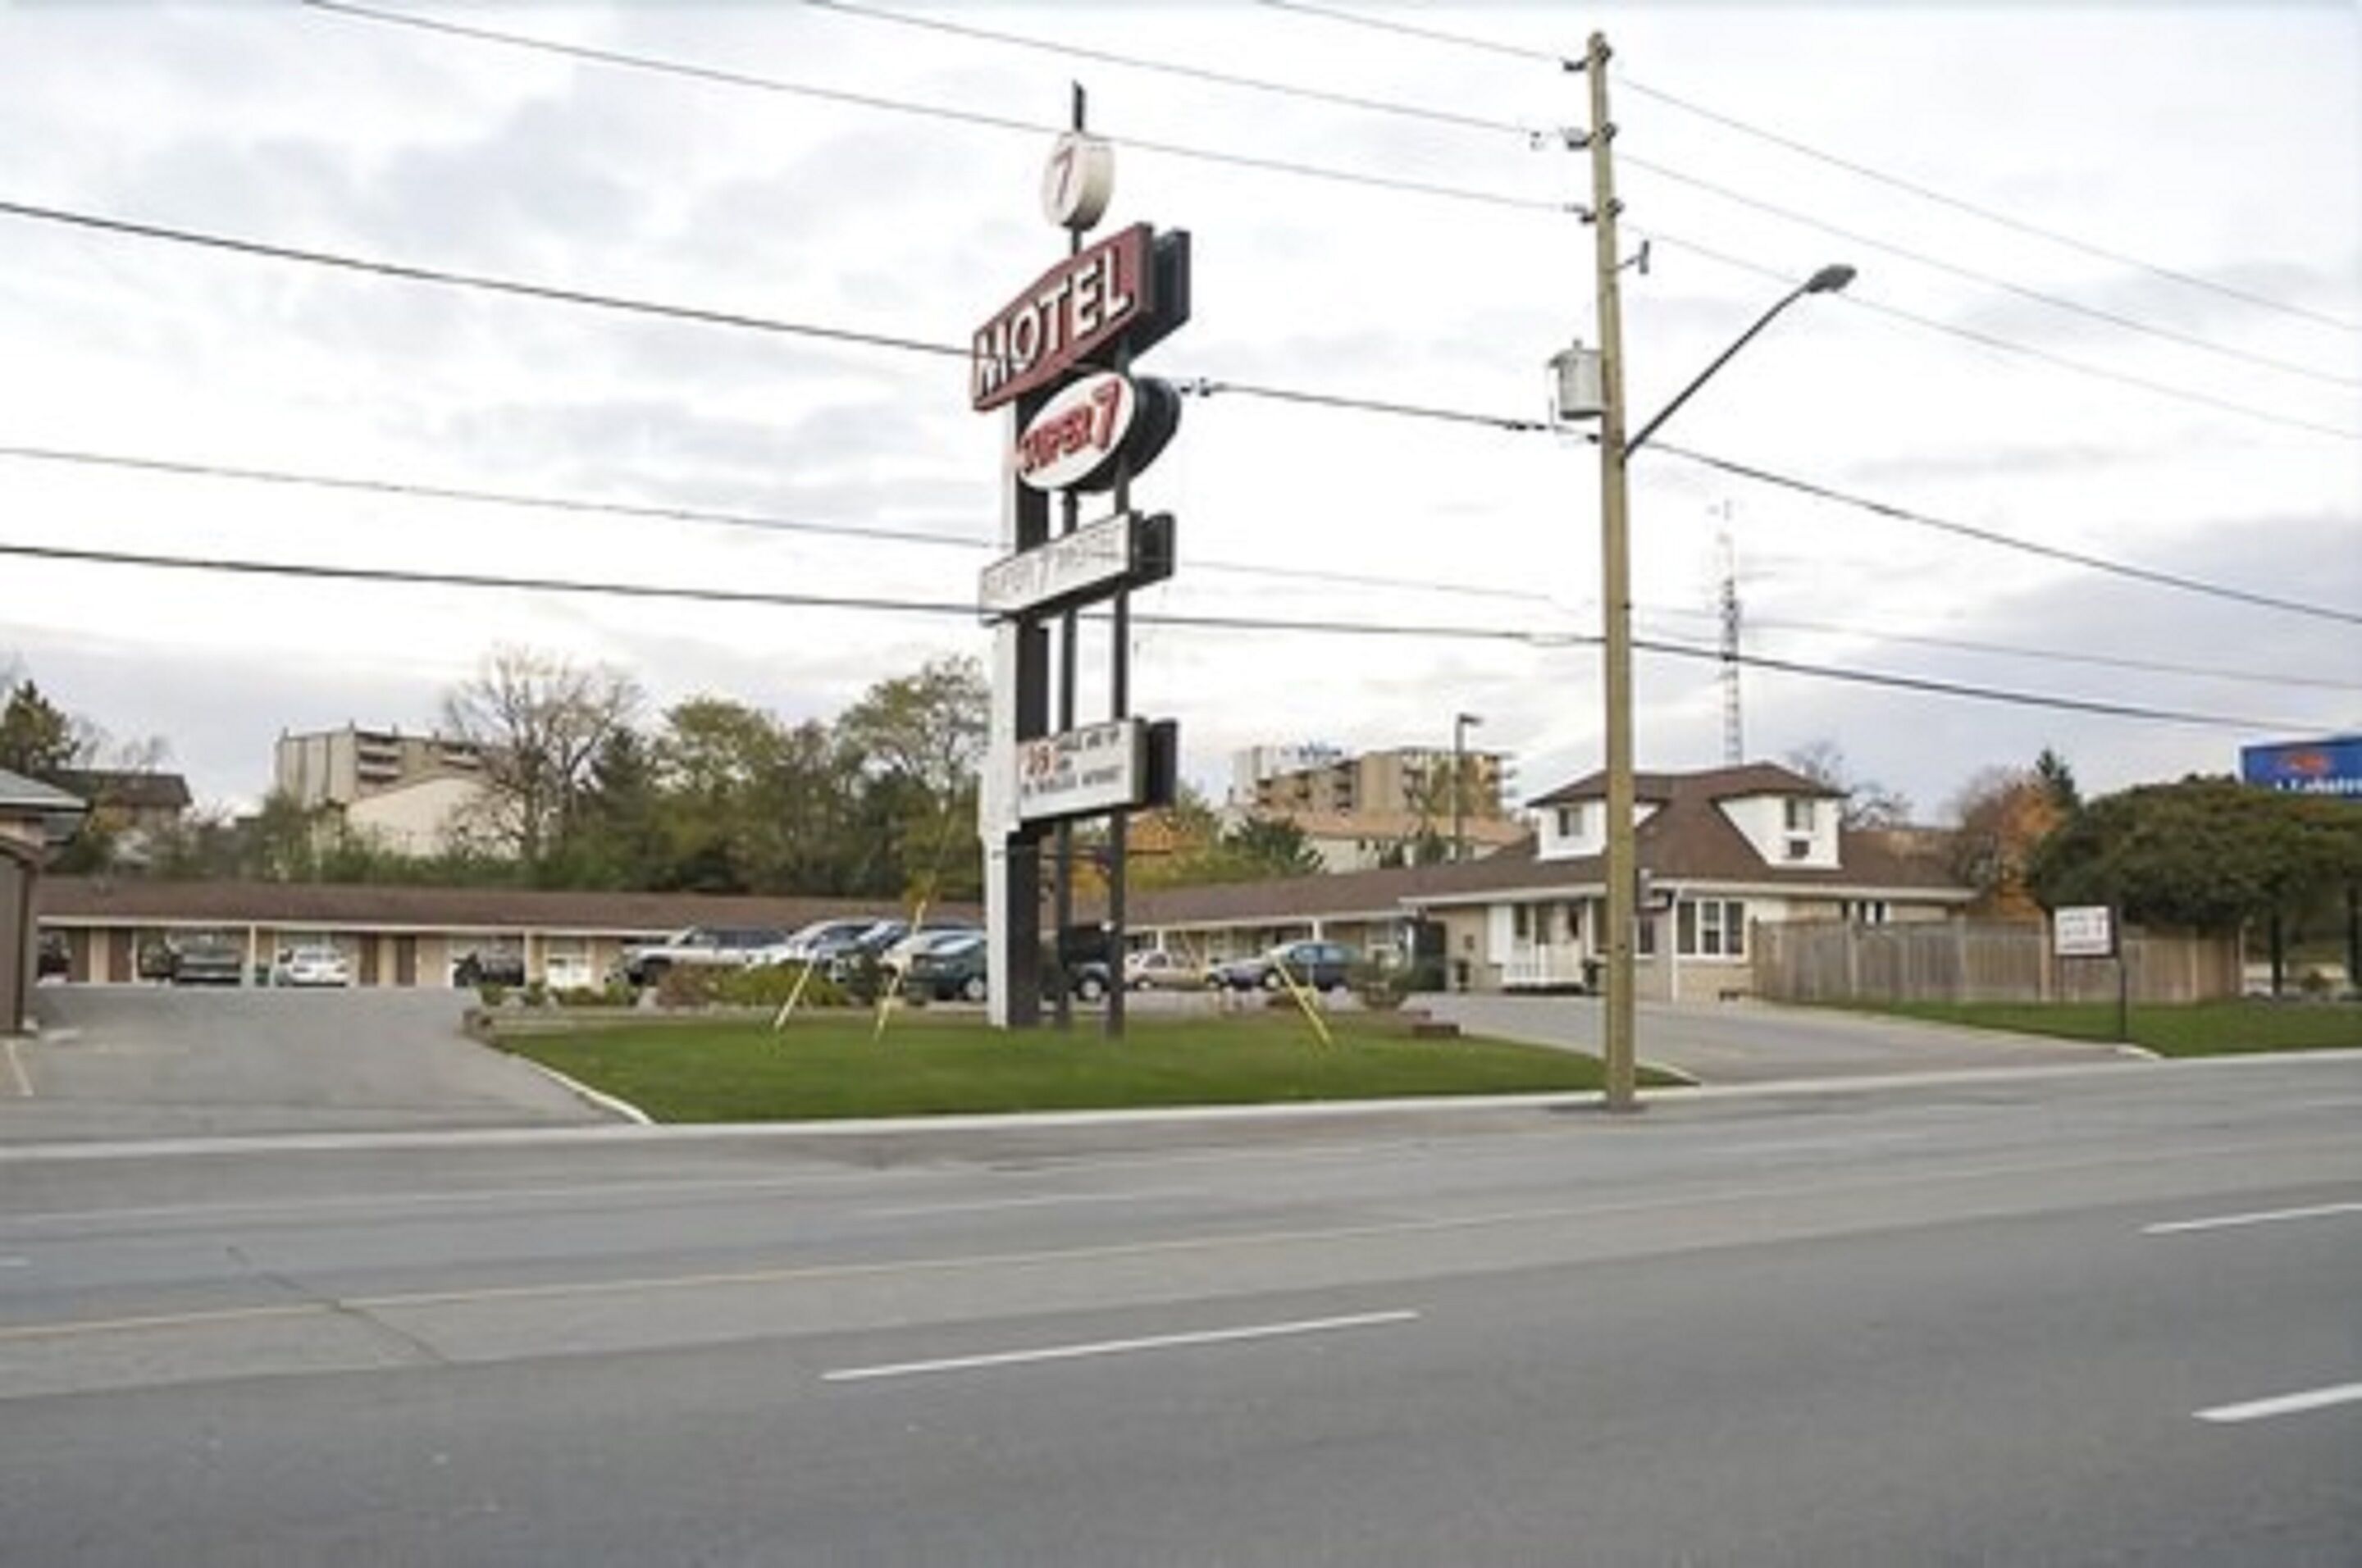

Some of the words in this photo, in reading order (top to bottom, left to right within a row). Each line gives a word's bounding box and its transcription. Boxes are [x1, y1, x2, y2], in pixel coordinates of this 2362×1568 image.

[1051, 146, 1075, 208] 7
[974, 246, 1132, 397] MOTEL
[1092, 378, 1122, 453] 7
